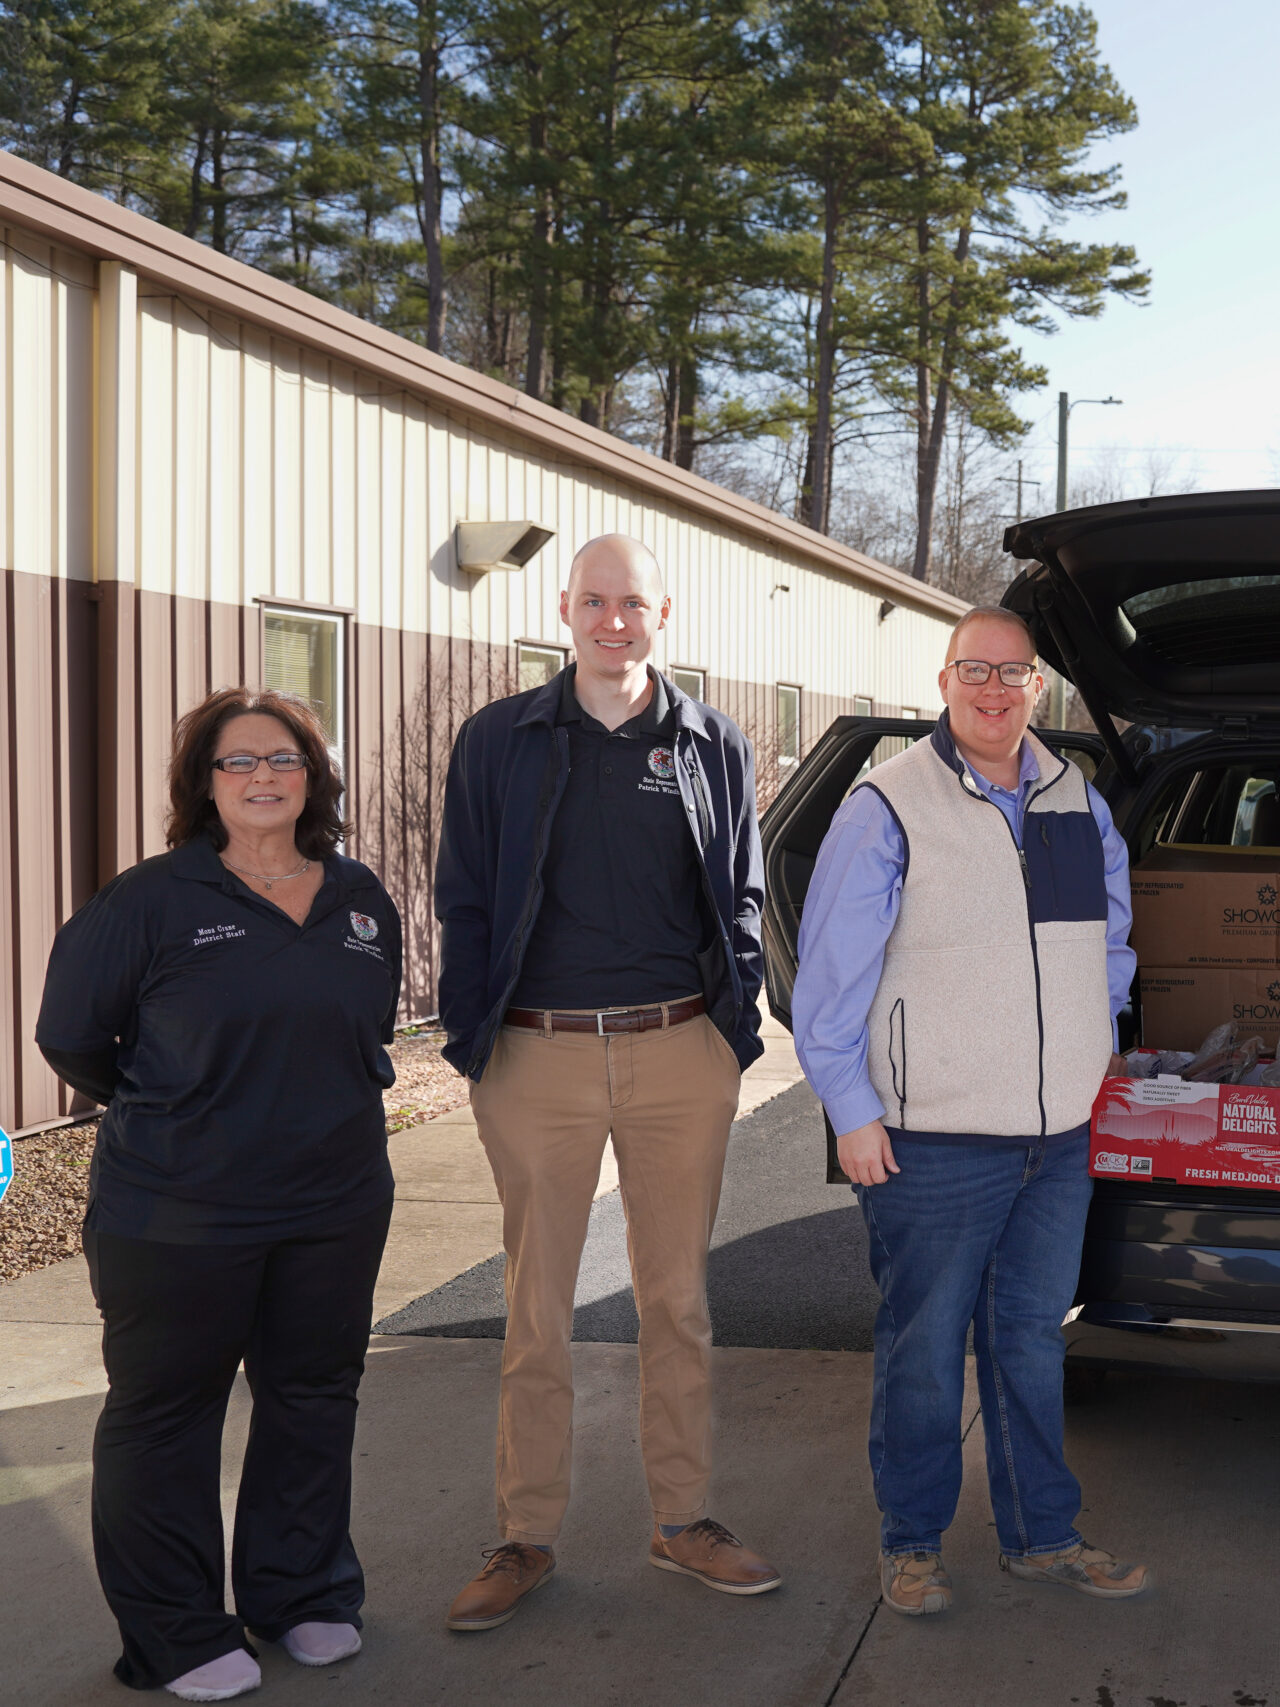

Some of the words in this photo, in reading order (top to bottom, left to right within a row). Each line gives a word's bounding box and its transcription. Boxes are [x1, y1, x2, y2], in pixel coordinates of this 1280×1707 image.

[638, 783, 660, 792] Patrick
[193, 933, 225, 946] District
[225, 929, 246, 938] Staff
[1246, 1094, 1270, 1107] Valley
[1223, 1103, 1277, 1121] NATURAL
[1215, 1145, 1280, 1155] NATURALDELIGHTS.COM
[1185, 1168, 1219, 1180] FRESH
[1222, 1170, 1272, 1184] MEDJOOL
